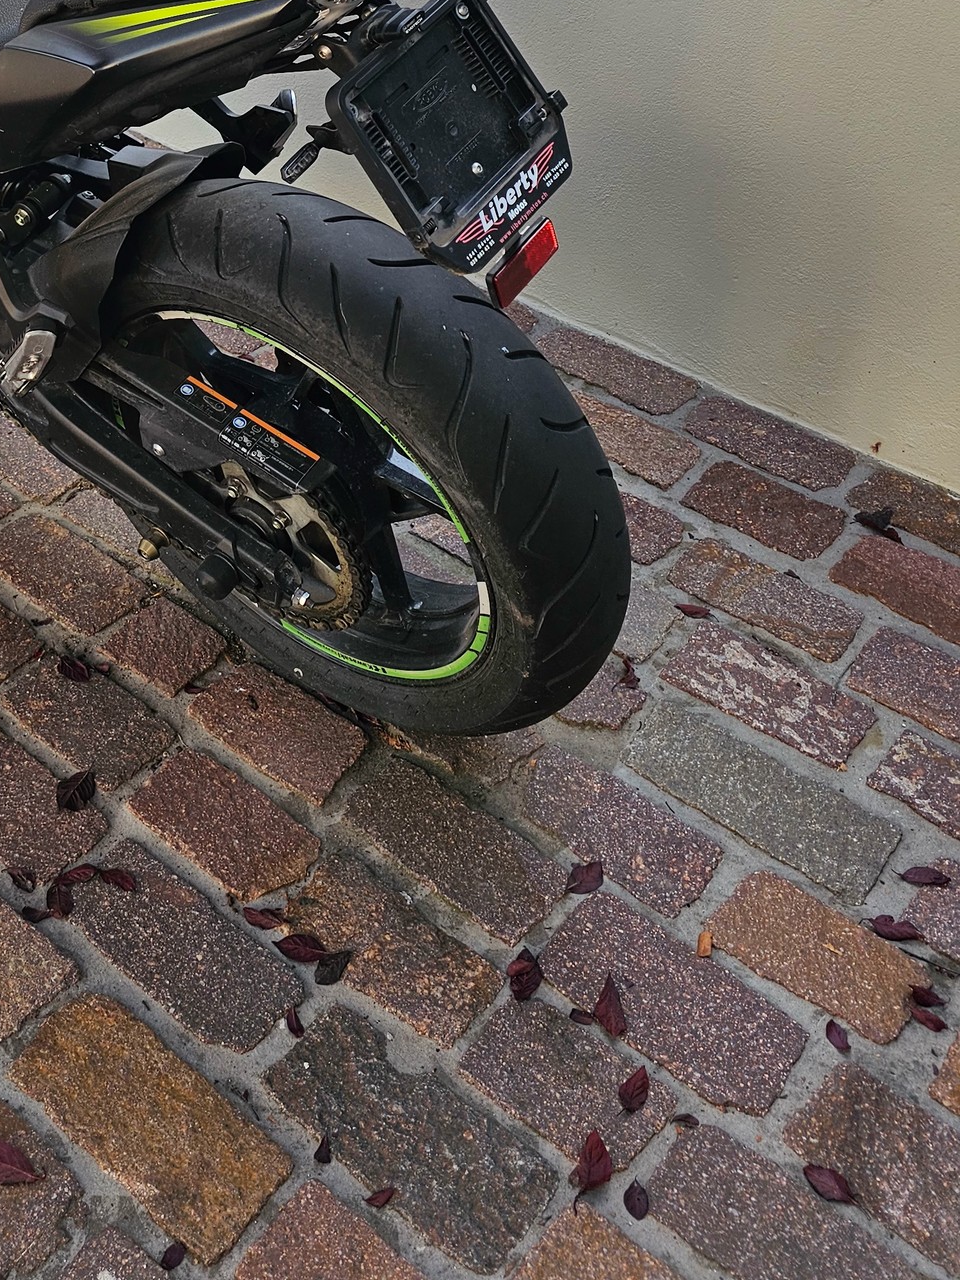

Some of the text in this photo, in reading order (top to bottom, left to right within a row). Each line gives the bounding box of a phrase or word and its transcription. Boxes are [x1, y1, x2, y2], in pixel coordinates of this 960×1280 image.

[478, 163, 539, 233] Liberty
[499, 191, 549, 244] www.libertymotos.ch
[507, 199, 529, 221] Motos
